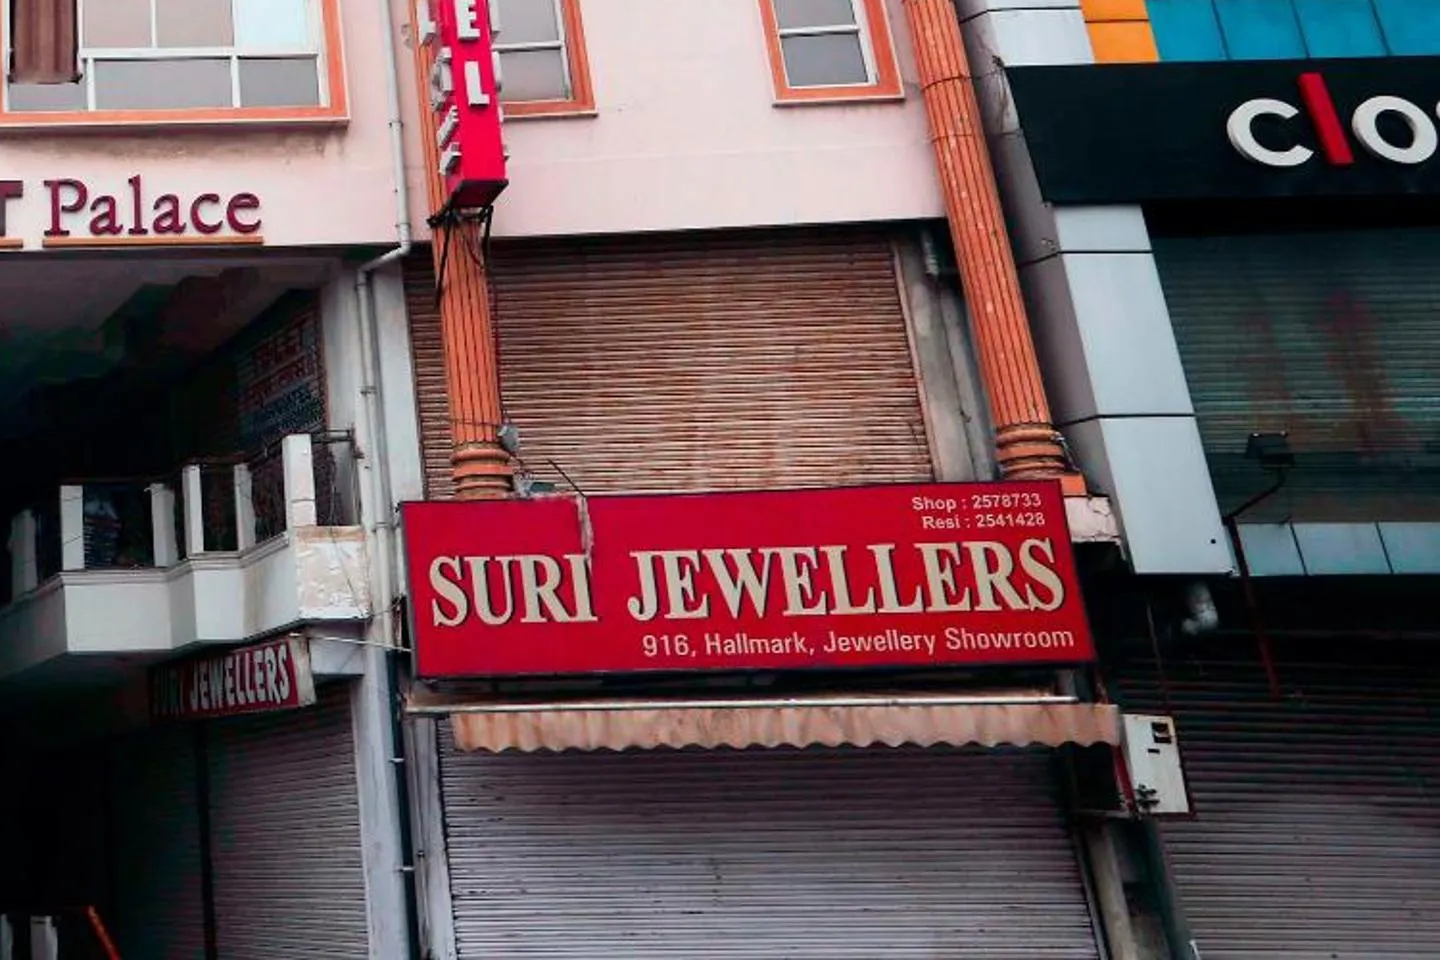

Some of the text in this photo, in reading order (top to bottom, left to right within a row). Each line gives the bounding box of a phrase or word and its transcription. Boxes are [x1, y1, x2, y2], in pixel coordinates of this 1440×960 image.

[44, 174, 262, 238] Palace
[911, 496, 957, 513] Shop
[971, 493, 1042, 510] 2578733
[922, 515, 961, 529] Resi
[975, 512, 1046, 528] 2541428
[429, 537, 1066, 628] SURI JEWELLERS
[642, 626, 1074, 658] 916, Hallmark, Jewellery Showroom
[189, 643, 291, 712] JEWELLERS
